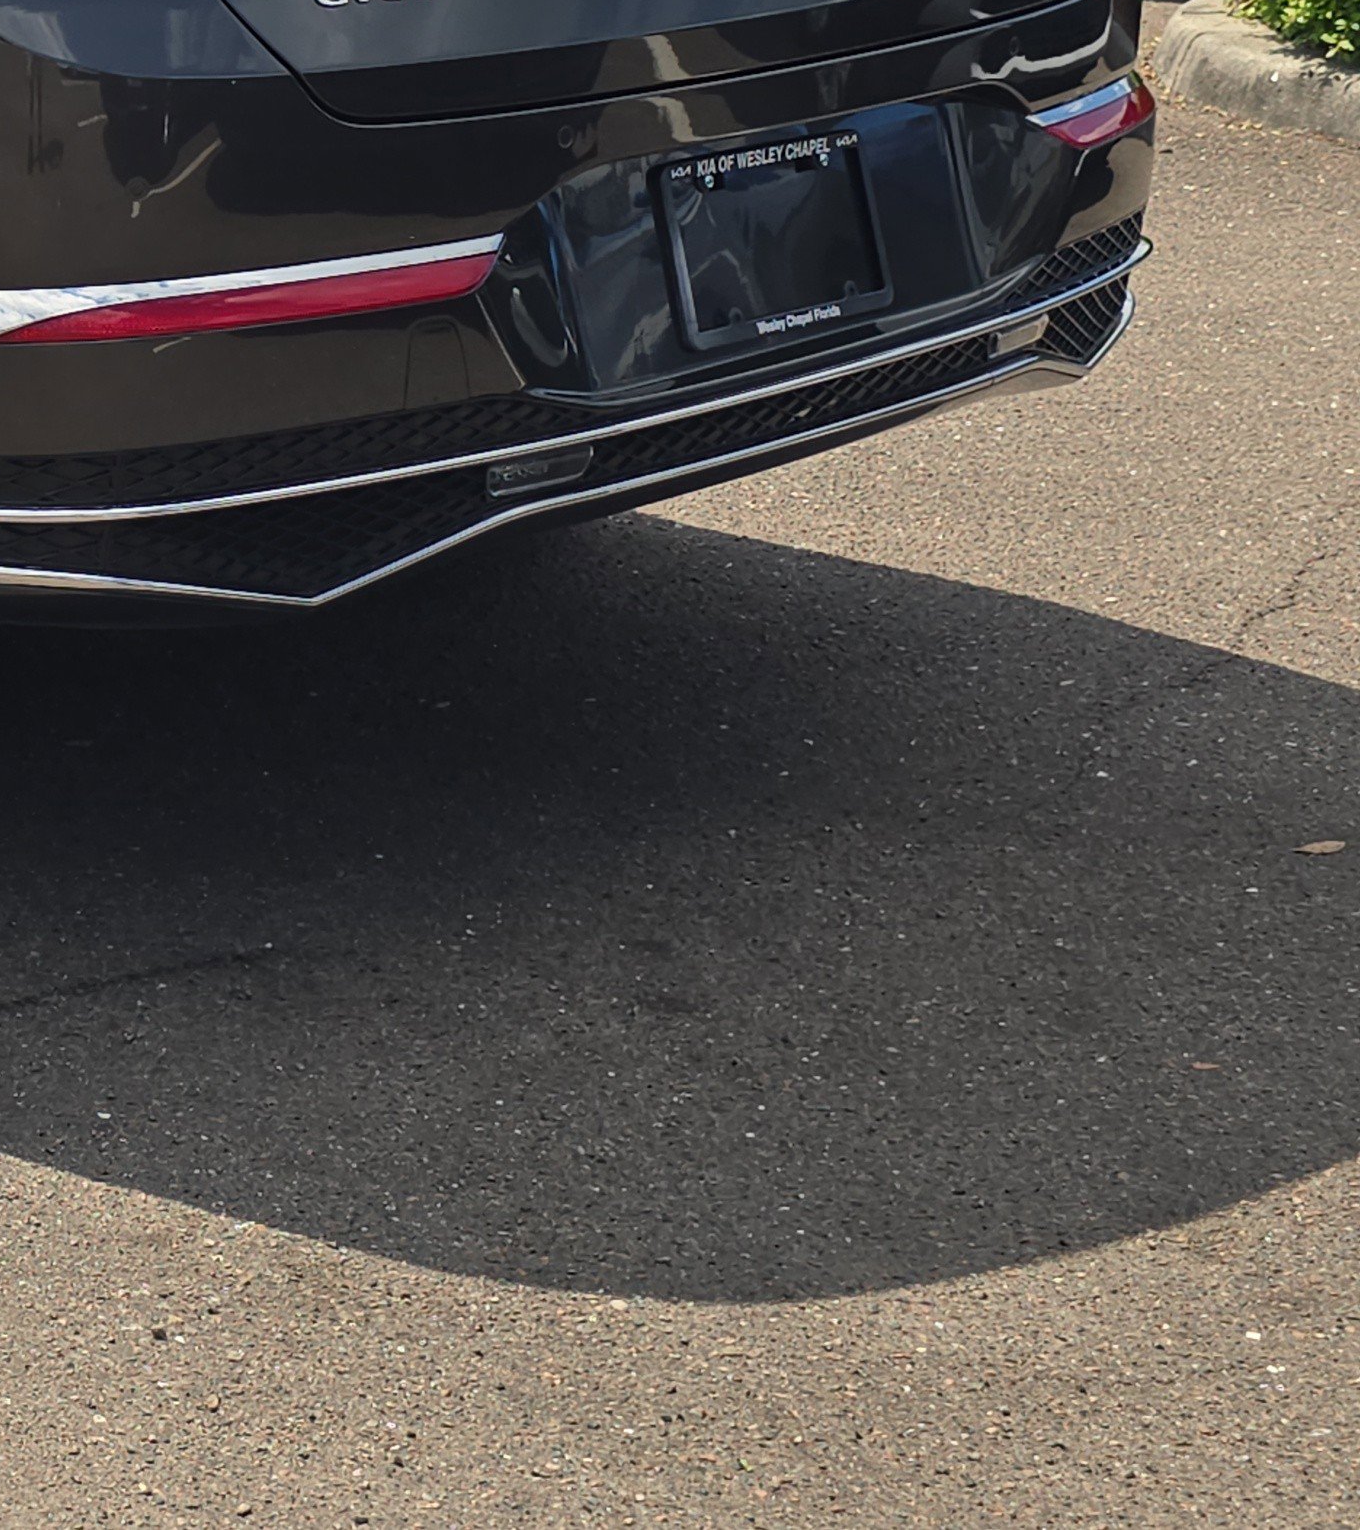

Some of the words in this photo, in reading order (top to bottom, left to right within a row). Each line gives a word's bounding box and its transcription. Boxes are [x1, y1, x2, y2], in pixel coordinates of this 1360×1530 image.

[717, 153, 735, 172] OF
[736, 144, 785, 170] WESLEY
[784, 136, 831, 161] CHAPEL
